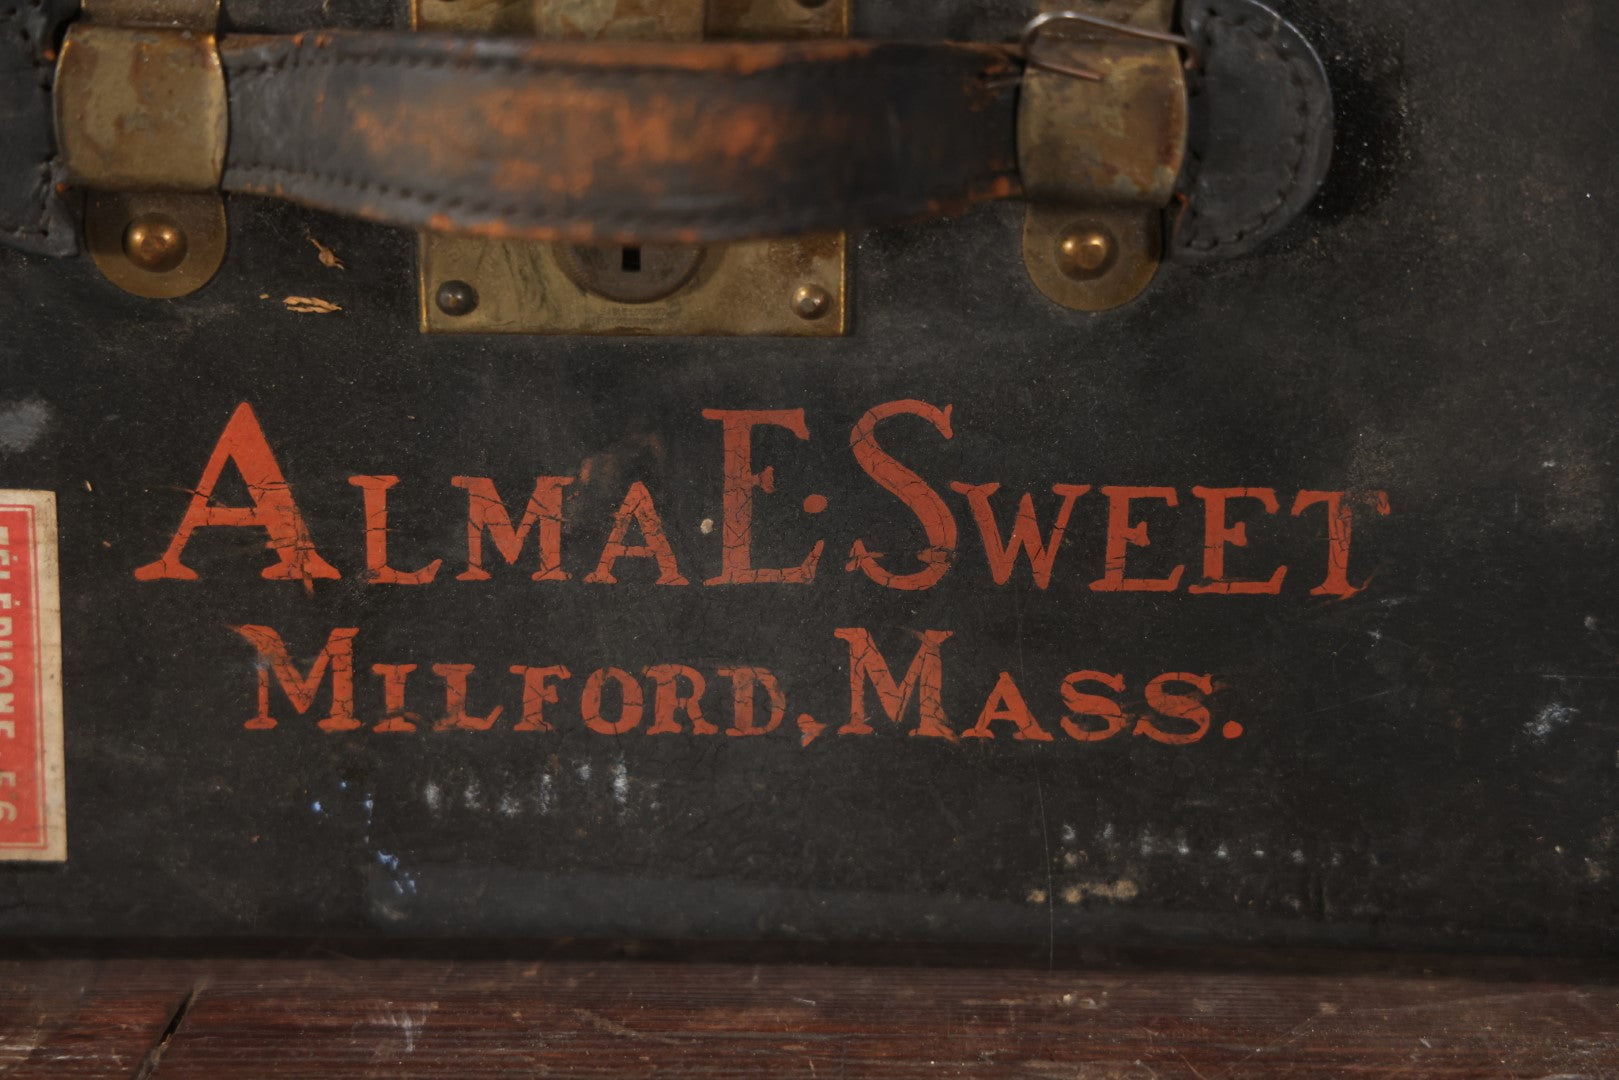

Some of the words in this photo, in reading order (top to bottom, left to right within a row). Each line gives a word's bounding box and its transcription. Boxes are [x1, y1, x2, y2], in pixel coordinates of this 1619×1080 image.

[134, 401, 689, 588] ALMA
[846, 399, 1392, 598] SWEET
[235, 624, 824, 748] MILFORD,
[833, 627, 1243, 744] MASS.
